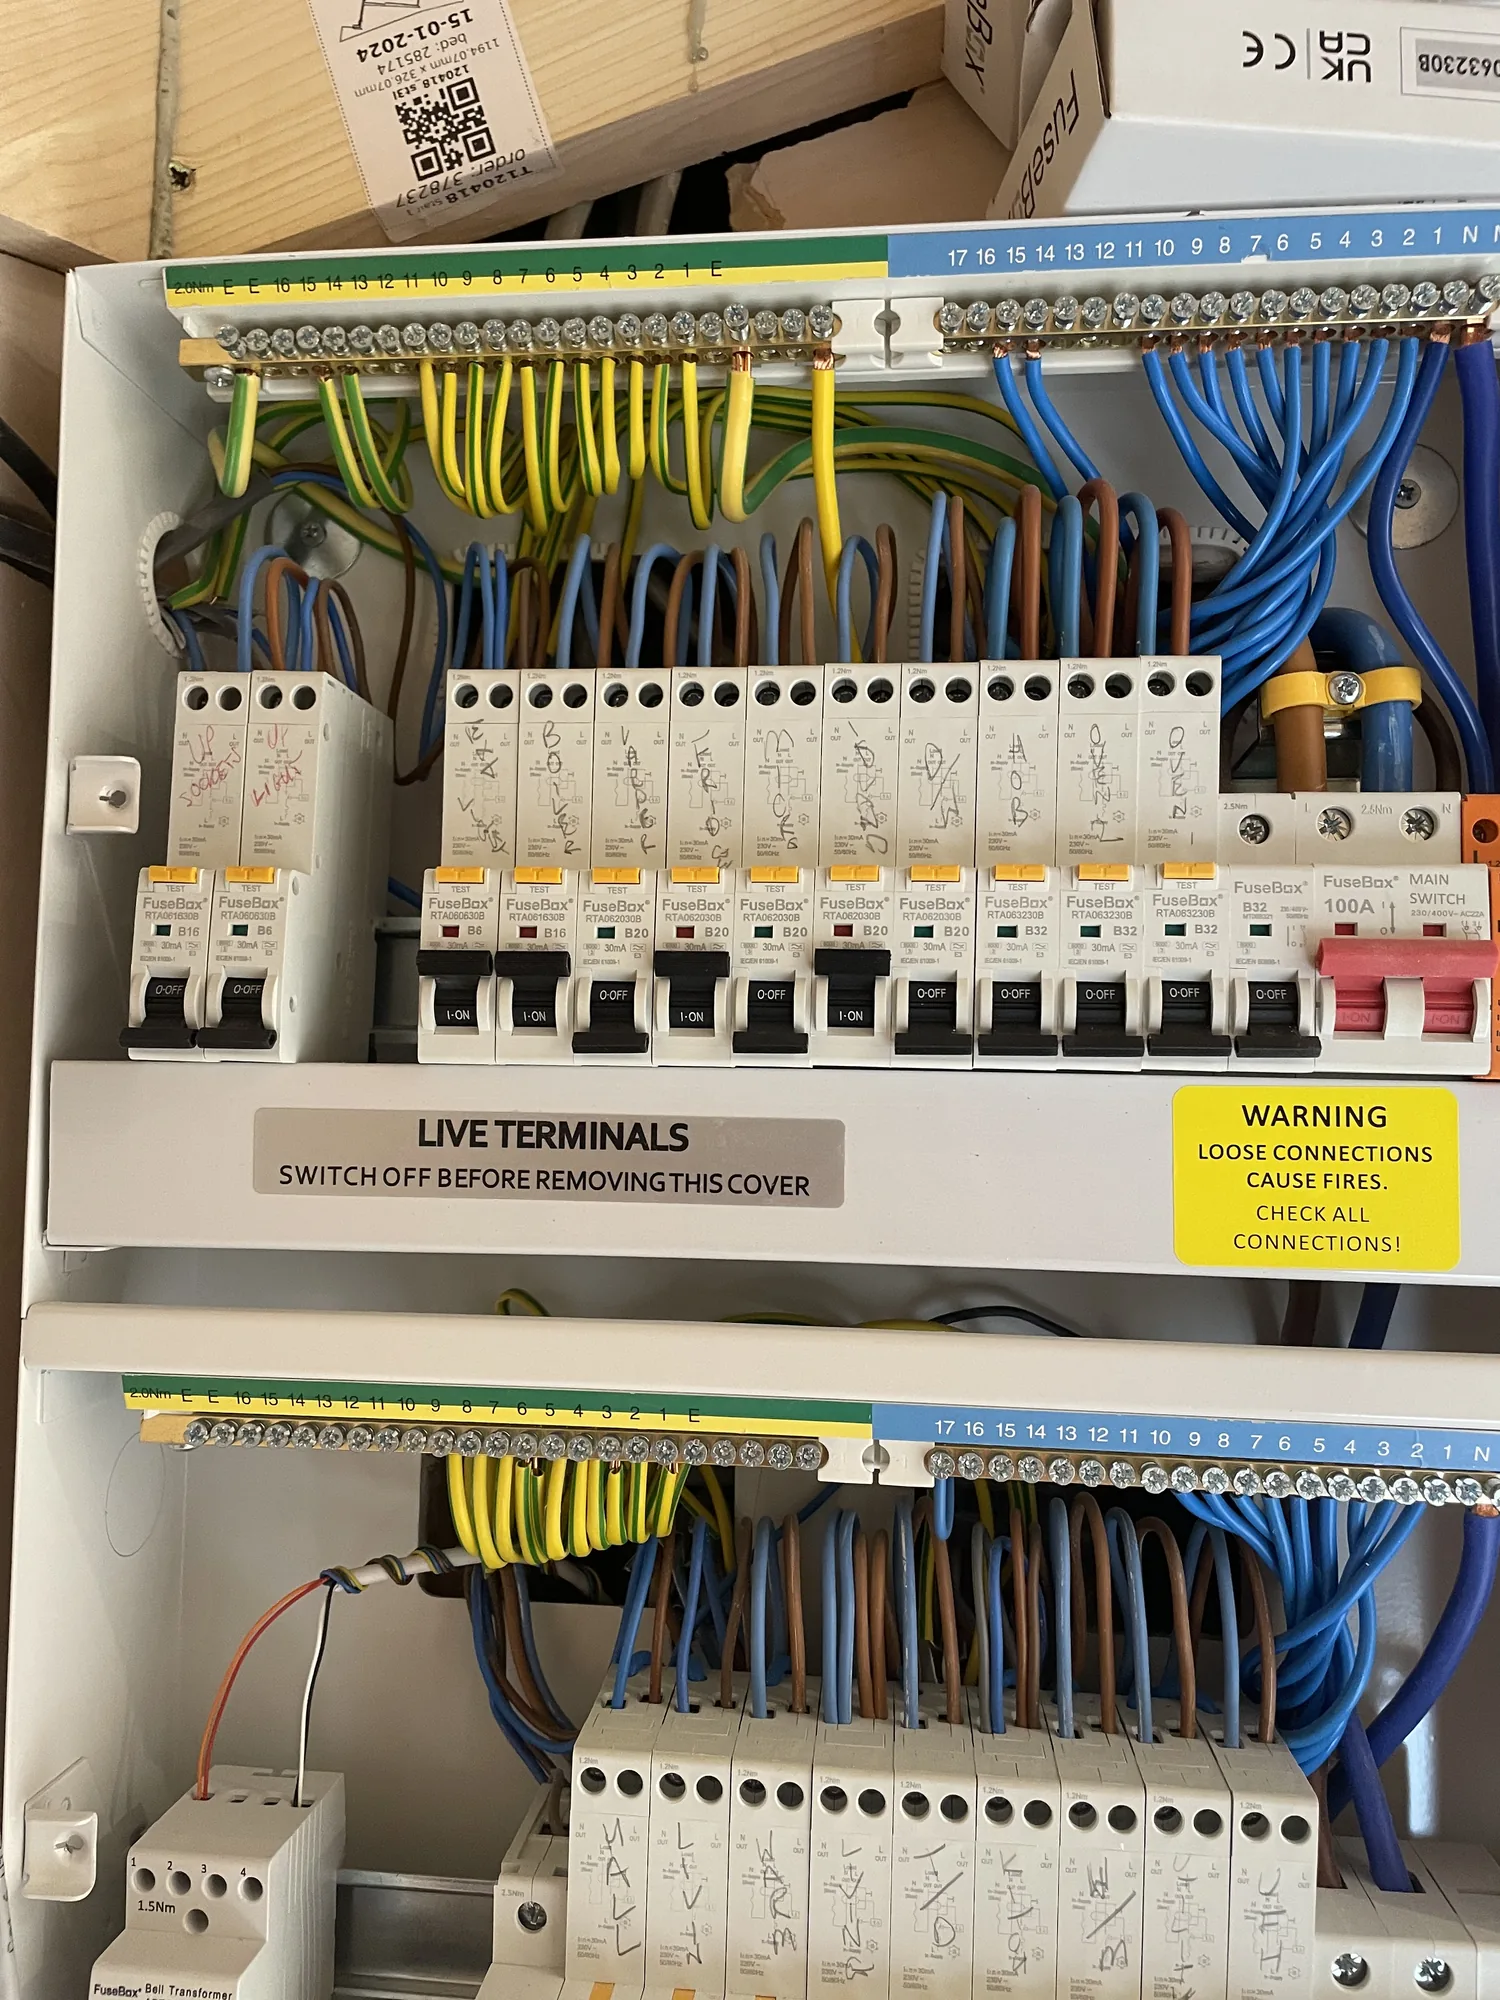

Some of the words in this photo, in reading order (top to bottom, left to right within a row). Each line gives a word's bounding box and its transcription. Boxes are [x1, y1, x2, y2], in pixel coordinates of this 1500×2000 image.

[356, 8, 473, 62] 15-01-2024
[436, 33, 468, 51] bed:
[377, 46, 429, 75] 285174
[431, 38, 500, 69] 1194.07mm
[354, 69, 418, 97] 326.07mm
[471, 148, 526, 172] order:
[396, 172, 464, 208] 378237
[447, 166, 534, 204] T120418
[948, 249, 968, 267] 17
[976, 248, 995, 266] 16
[1006, 246, 1026, 264] 15
[1036, 245, 1055, 262] 14
[1065, 243, 1084, 261] 13
[1095, 242, 1115, 260] 12
[1125, 240, 1143, 258] 11
[1155, 239, 1175, 257] 10
[1191, 238, 1204, 255] 9
[1219, 236, 1231, 254] 8
[1250, 235, 1262, 252] 7
[1277, 234, 1289, 251] 6
[1310, 232, 1322, 250] 5
[1339, 231, 1351, 248] 4
[1371, 230, 1383, 247] 3
[1403, 229, 1415, 246] 2
[1433, 227, 1441, 245] 1
[1463, 225, 1478, 244] N
[174, 281, 214, 295] 2.0Nm
[223, 279, 234, 294] E
[250, 278, 260, 293] E
[274, 277, 290, 293] 16
[300, 276, 316, 292] 15
[326, 275, 343, 291] 14
[352, 275, 368, 290] 13
[378, 273, 394, 289] 12
[404, 272, 418, 288] 11
[432, 271, 448, 287] 10
[462, 270, 472, 285] 9
[493, 270, 502, 285] 8
[519, 268, 528, 283] 7
[546, 267, 555, 282] 6
[573, 266, 582, 281] 5
[600, 266, 610, 280] 4
[627, 264, 637, 280] 3
[655, 263, 664, 279] 2
[683, 262, 690, 278] 1
[711, 261, 722, 276] E
[1409, 873, 1449, 886] MAIN
[1243, 902, 1267, 913] B32
[1324, 898, 1375, 914] 100A
[1409, 892, 1466, 906] SWITCH
[178, 926, 200, 937] B16
[467, 926, 482, 935] B6
[705, 927, 729, 937] B20
[1025, 926, 1047, 936] B32
[923, 942, 946, 951] 30mA
[1242, 1104, 1387, 1128] WARNING
[419, 1118, 488, 1148] LIVE
[494, 1120, 690, 1152] TERMINALS
[1198, 1143, 1266, 1160] LOOSE
[1273, 1144, 1433, 1162] CONNECTIONS
[279, 1164, 376, 1187] SWITCH
[383, 1166, 431, 1187] OFF
[438, 1168, 530, 1190] BEFORE
[536, 1169, 666, 1193] REMOVING
[669, 1172, 723, 1194] THIS
[728, 1174, 810, 1197] COVER
[1246, 1172, 1316, 1189] CAUSE
[1323, 1173, 1388, 1190] FIRES.
[1256, 1205, 1326, 1222] CHECK
[1332, 1207, 1370, 1222] ALL
[1233, 1233, 1401, 1252] CONNECTIONS!
[130, 1387, 172, 1400] 2.0Nm
[181, 1389, 192, 1403] E
[208, 1389, 219, 1404] E
[233, 1391, 251, 1405] 16
[261, 1392, 278, 1406] 15
[288, 1393, 305, 1407] 14
[315, 1394, 332, 1408] 13
[341, 1395, 359, 1409] 12
[368, 1396, 385, 1410] 11
[399, 1397, 416, 1411] 10
[431, 1398, 441, 1413] 9
[462, 1399, 472, 1414] 8
[489, 1400, 499, 1415] 7
[517, 1402, 527, 1416] 6
[545, 1403, 555, 1417] 5
[573, 1403, 584, 1418] 4
[602, 1405, 612, 1419] 3
[630, 1406, 640, 1420] 2
[660, 1407, 667, 1421] 1
[688, 1408, 699, 1423] E
[935, 1420, 955, 1435] 17
[964, 1421, 984, 1437] 16
[995, 1423, 1016, 1438] 15
[1026, 1424, 1046, 1439] 14
[1056, 1425, 1077, 1441] 13
[1088, 1427, 1109, 1442] 12
[1119, 1428, 1138, 1444] 11
[1150, 1430, 1171, 1445] 10
[1188, 1431, 1201, 1447] 9
[1218, 1433, 1230, 1448] 8
[1250, 1434, 1263, 1449] 7
[1278, 1436, 1291, 1451] 6
[1313, 1437, 1325, 1452] 5
[1344, 1439, 1356, 1454] 4
[1377, 1441, 1390, 1456] 3
[1411, 1443, 1424, 1458] 2
[1443, 1445, 1451, 1460] 1
[1474, 1446, 1491, 1462] N
[131, 1857, 136, 1867] 1
[167, 1861, 173, 1871] 2
[201, 1864, 207, 1873] 3
[240, 1868, 246, 1877] 4
[138, 1900, 176, 1914] 1.5Nm
[145, 1983, 164, 1994] Bell
[169, 1985, 232, 2000] Transformer
